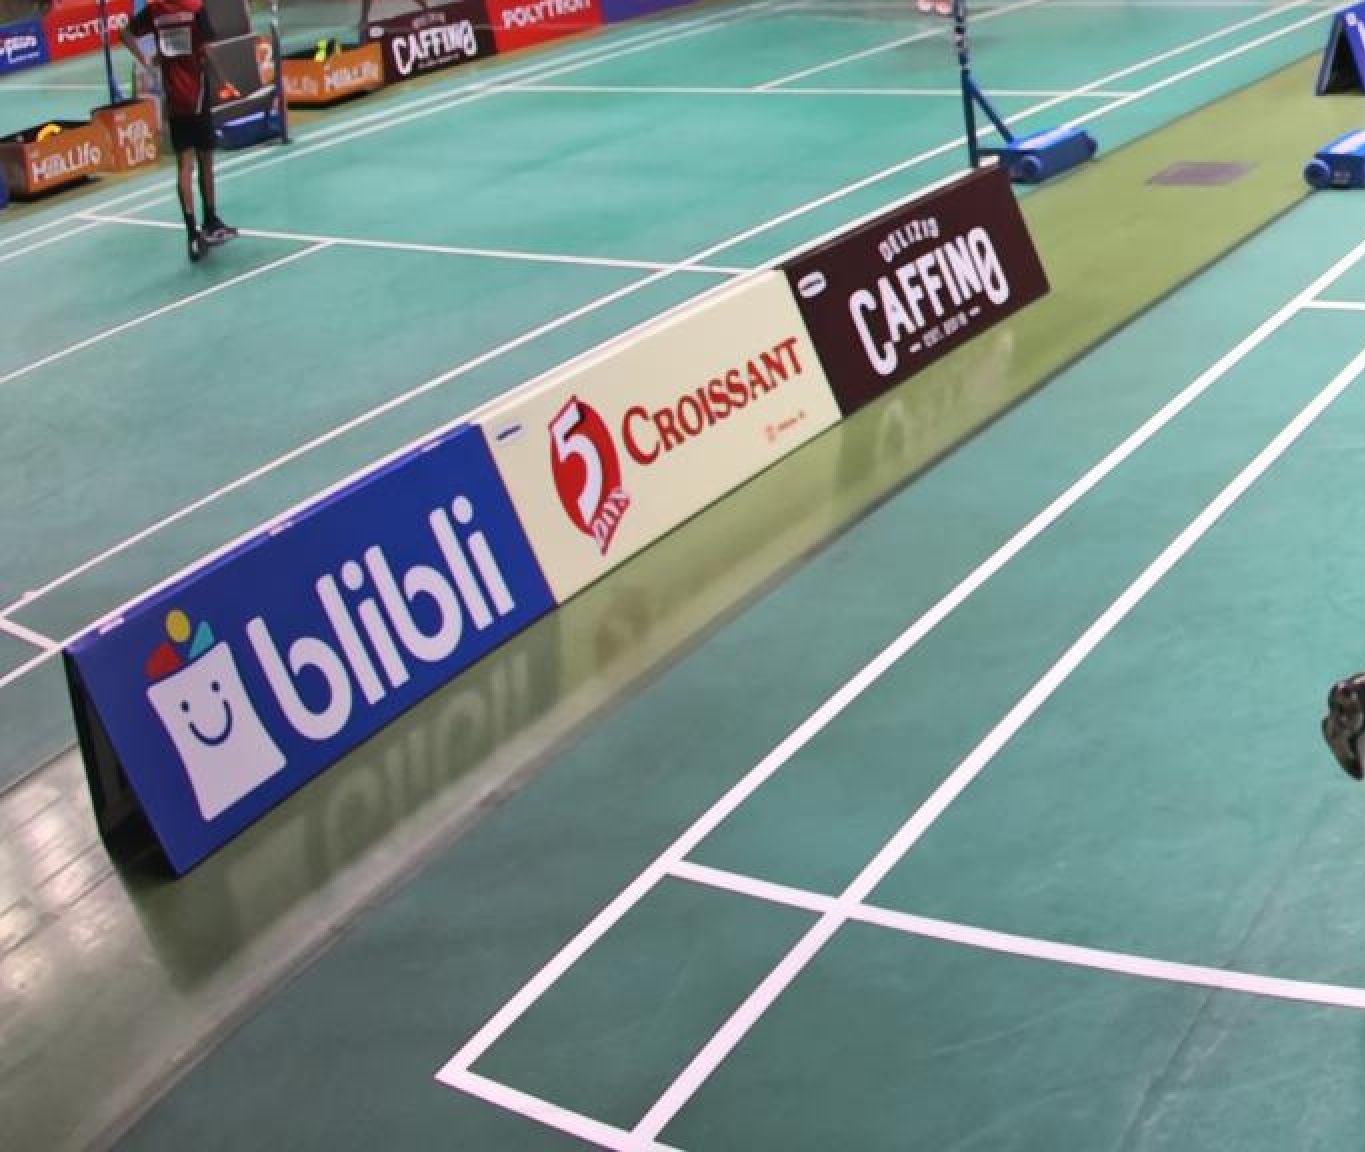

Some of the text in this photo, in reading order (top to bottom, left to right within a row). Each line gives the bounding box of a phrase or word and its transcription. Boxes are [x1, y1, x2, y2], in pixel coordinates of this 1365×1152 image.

[849, 226, 1010, 376] CAFFINO
[550, 396, 604, 531] 5
[621, 335, 803, 466] CROISSANT
[245, 495, 516, 741] blibli
